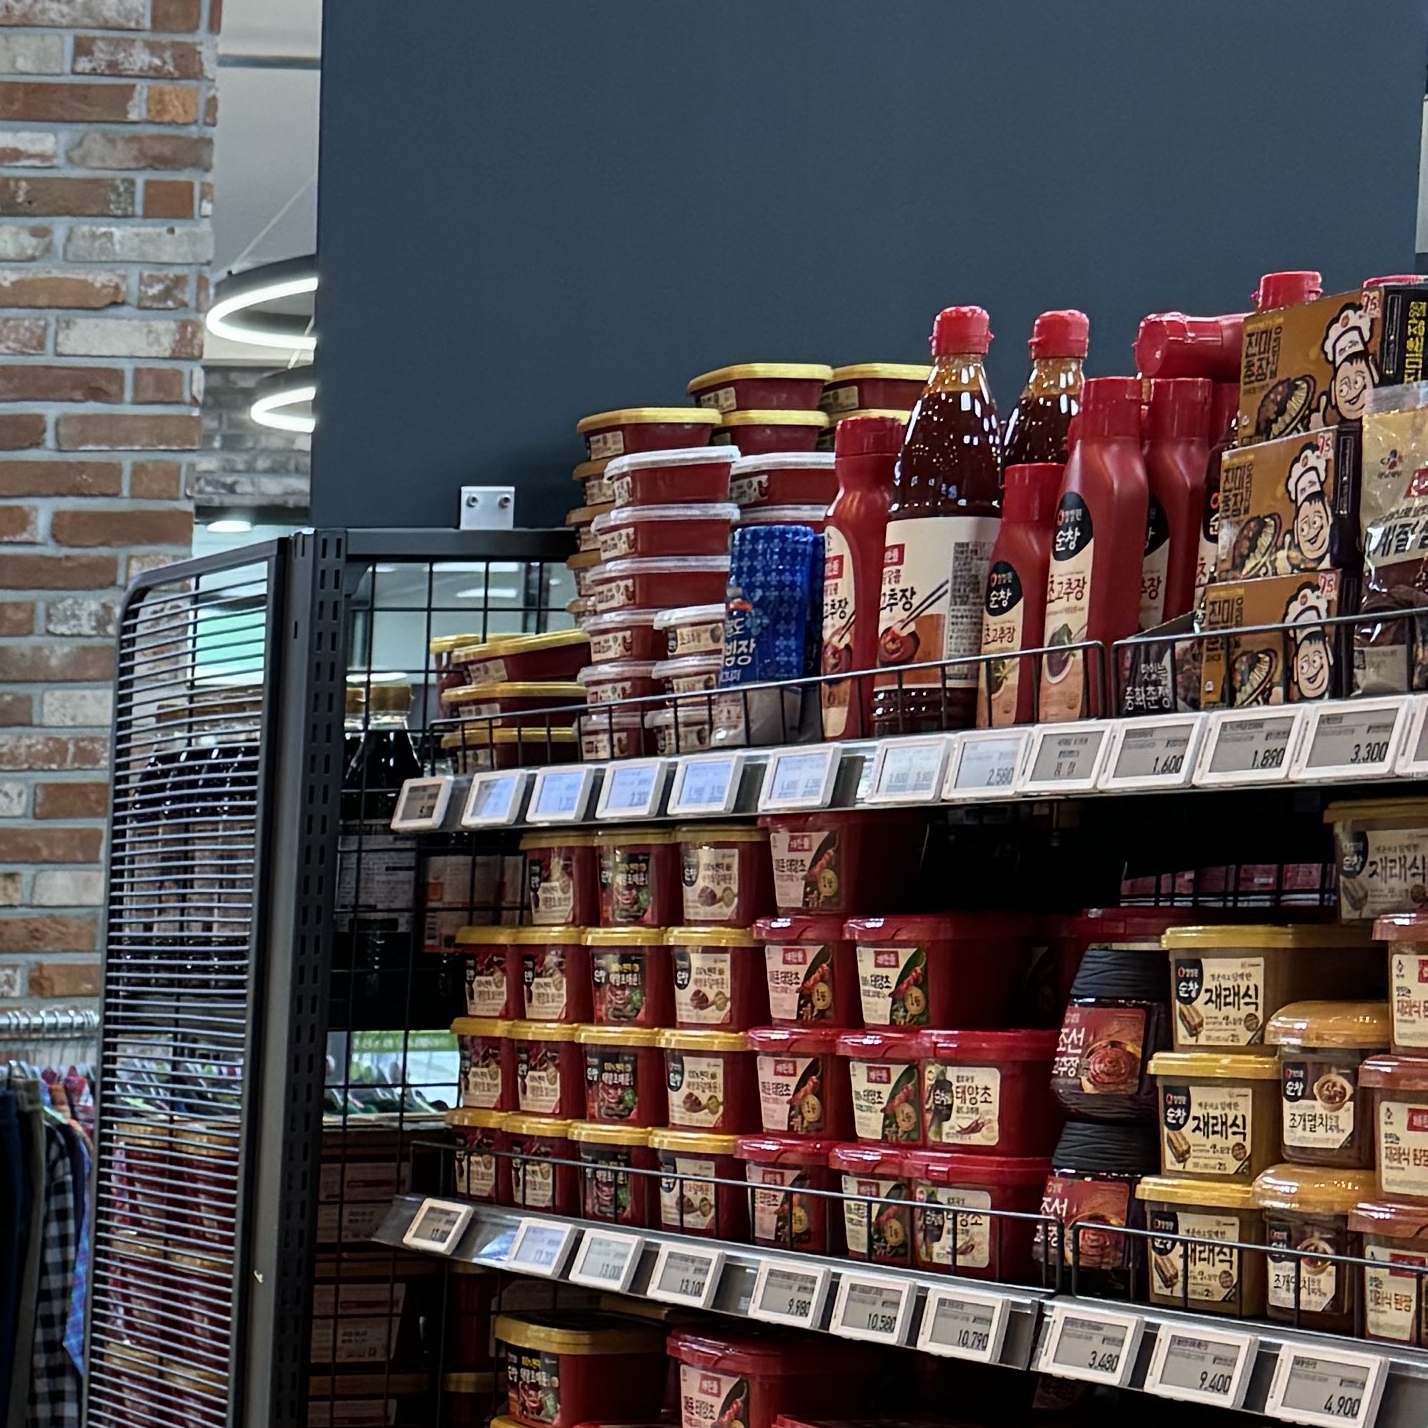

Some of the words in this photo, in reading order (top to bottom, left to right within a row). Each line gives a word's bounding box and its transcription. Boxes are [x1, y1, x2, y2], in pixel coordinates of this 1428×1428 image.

[1245, 328, 1273, 358] 진미
[1054, 528, 1081, 552] 순창
[988, 589, 1013, 609] 순창
[1047, 574, 1088, 605] 초고추장
[982, 623, 1016, 646] 초고추장
[1368, 855, 1426, 884] 재래식
[1178, 981, 1200, 999] 순창
[1204, 983, 1260, 1012] 재래식
[955, 1084, 993, 1106] 태양초
[1285, 1080, 1305, 1097] 순창
[1166, 1109, 1188, 1125] 순창
[1191, 1113, 1248, 1142] 재래식
[1289, 1112, 1329, 1134] 조개멸치
[1199, 1370, 1233, 1394] 9,400
[1323, 1393, 1361, 1419] 4,900
